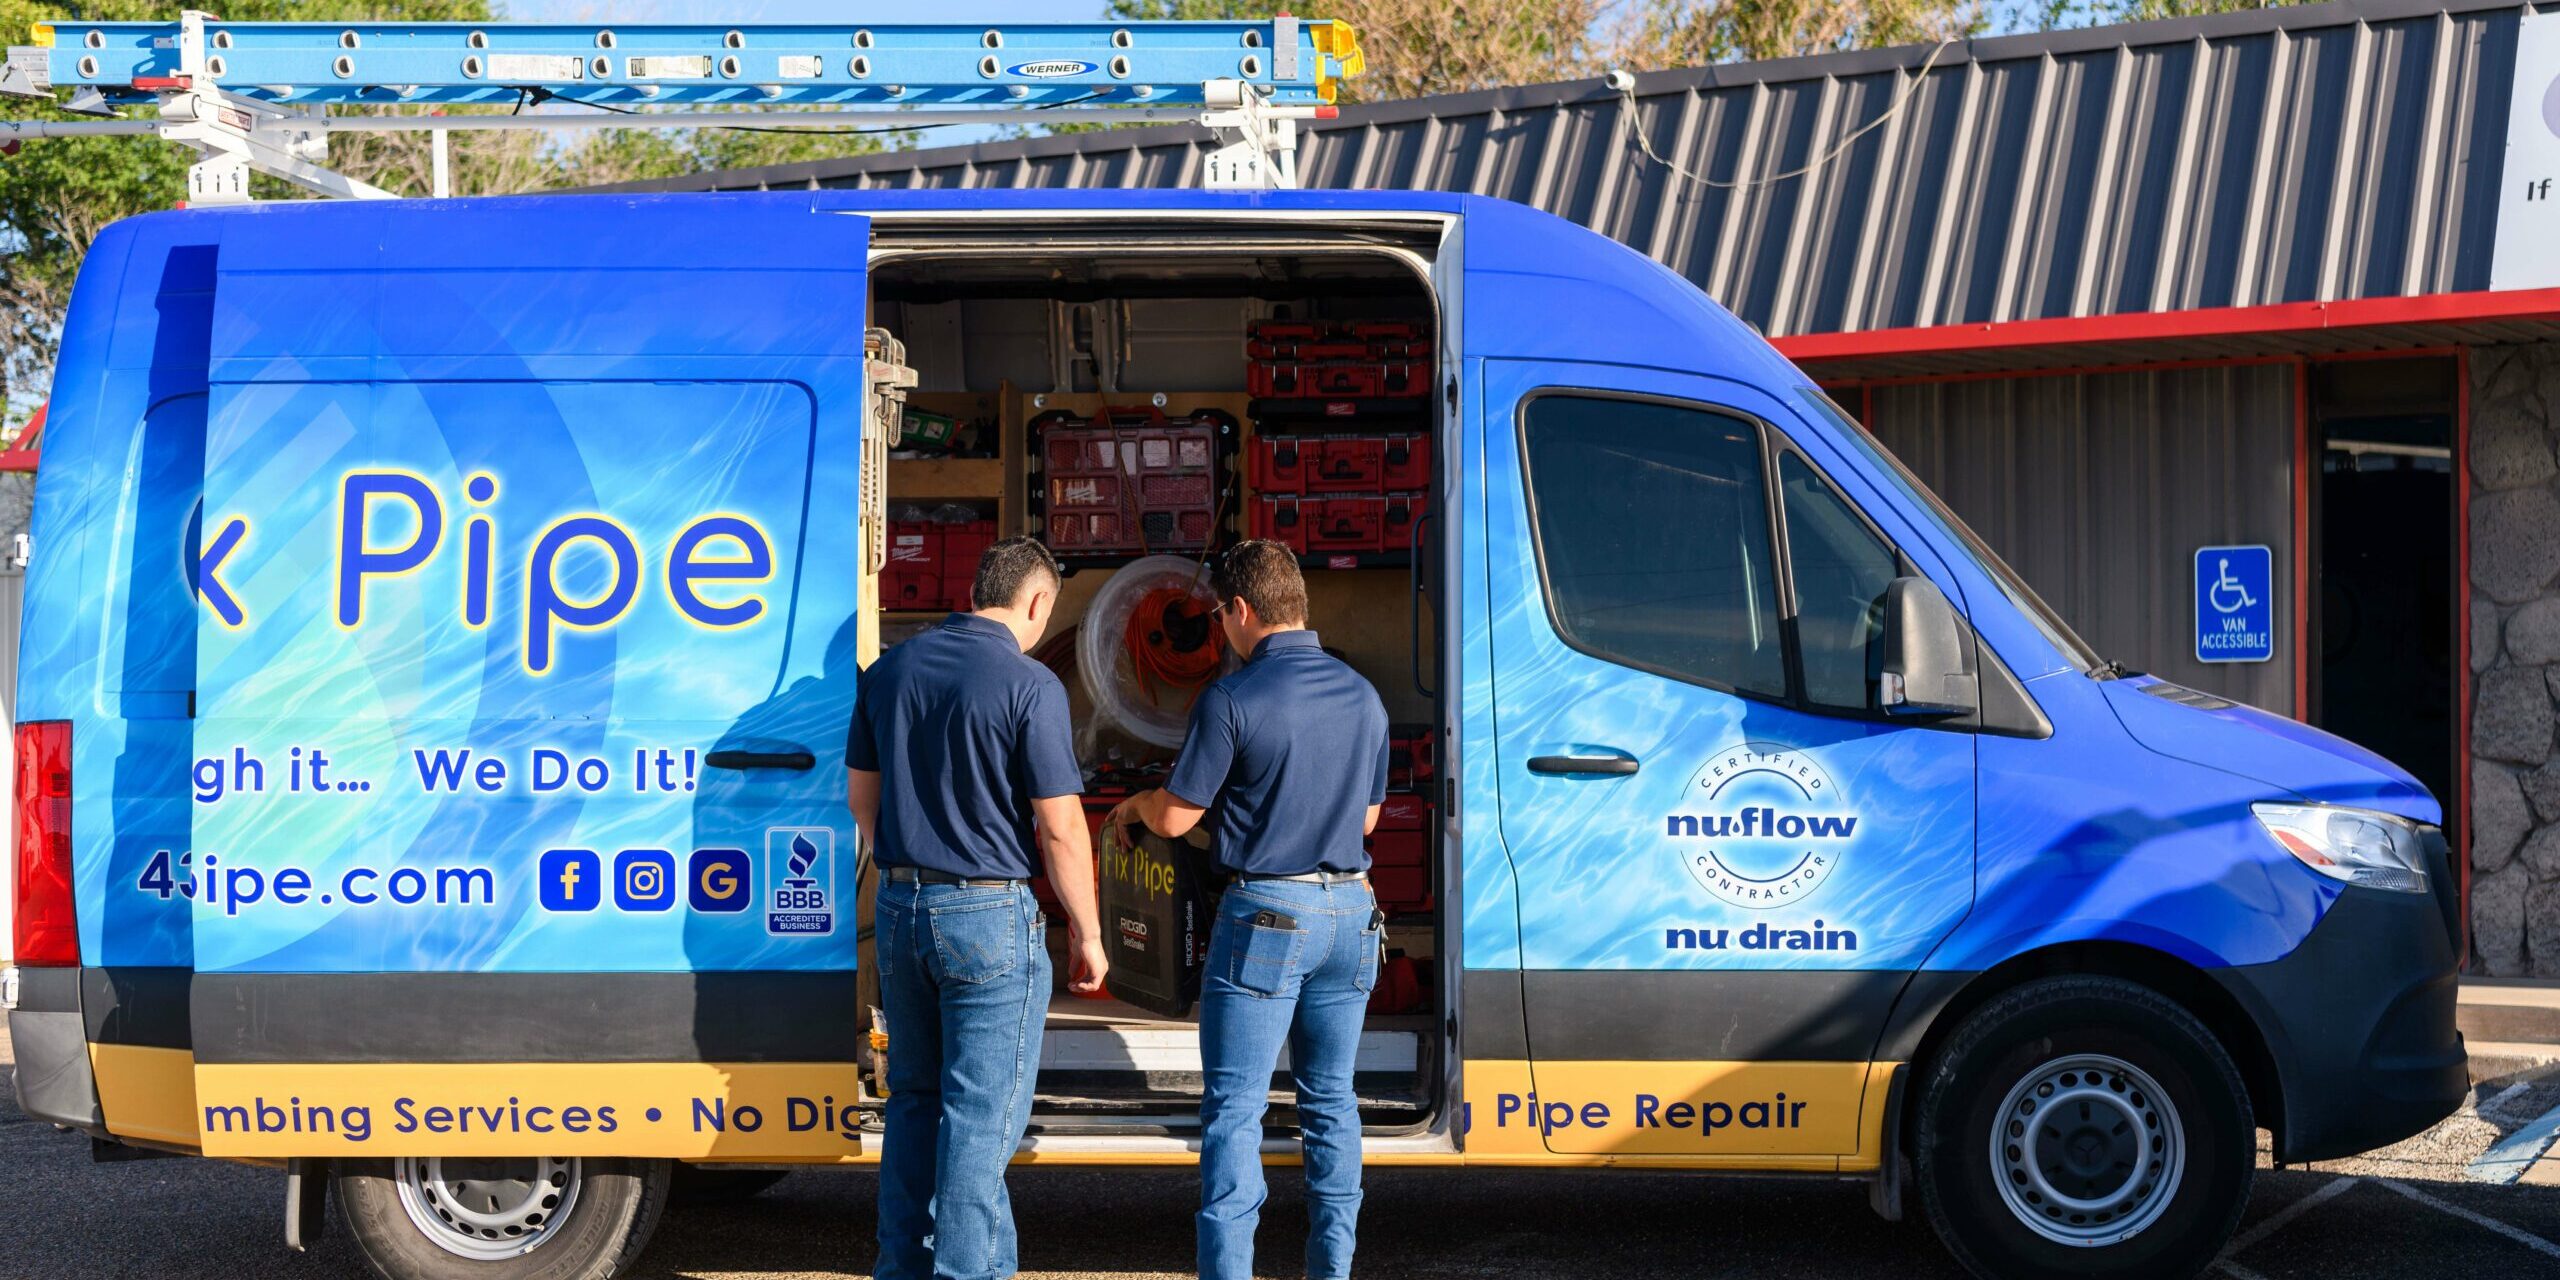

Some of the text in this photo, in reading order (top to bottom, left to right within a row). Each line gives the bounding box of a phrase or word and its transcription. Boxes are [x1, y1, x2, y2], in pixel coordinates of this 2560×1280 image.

[1025, 64, 1081, 74] WERNER
[2527, 178, 2552, 201] If
[336, 472, 773, 674] Pipe
[2222, 617, 2247, 632] VAN
[2201, 633, 2268, 649] ACCESSIBLE
[414, 749, 506, 792] We
[532, 749, 609, 792] Do
[636, 749, 697, 792] It!
[1701, 752, 1821, 790] CERTIFIED
[1105, 838, 1176, 901] Fix Pipe
[1697, 856, 1826, 900] CONTRACTOR
[776, 890, 825, 909] BBB
[773, 914, 827, 923] ACCREDITED
[780, 922, 821, 930] BUSINESS
[1119, 917, 1148, 936] RIDGID
[1185, 932, 1194, 967] RIDGID
[204, 1096, 373, 1142] mbing
[393, 1097, 619, 1133] Services
[691, 1097, 763, 1133] No
[1497, 1091, 1611, 1137] Pipe
[1635, 1091, 1808, 1137] Repair
